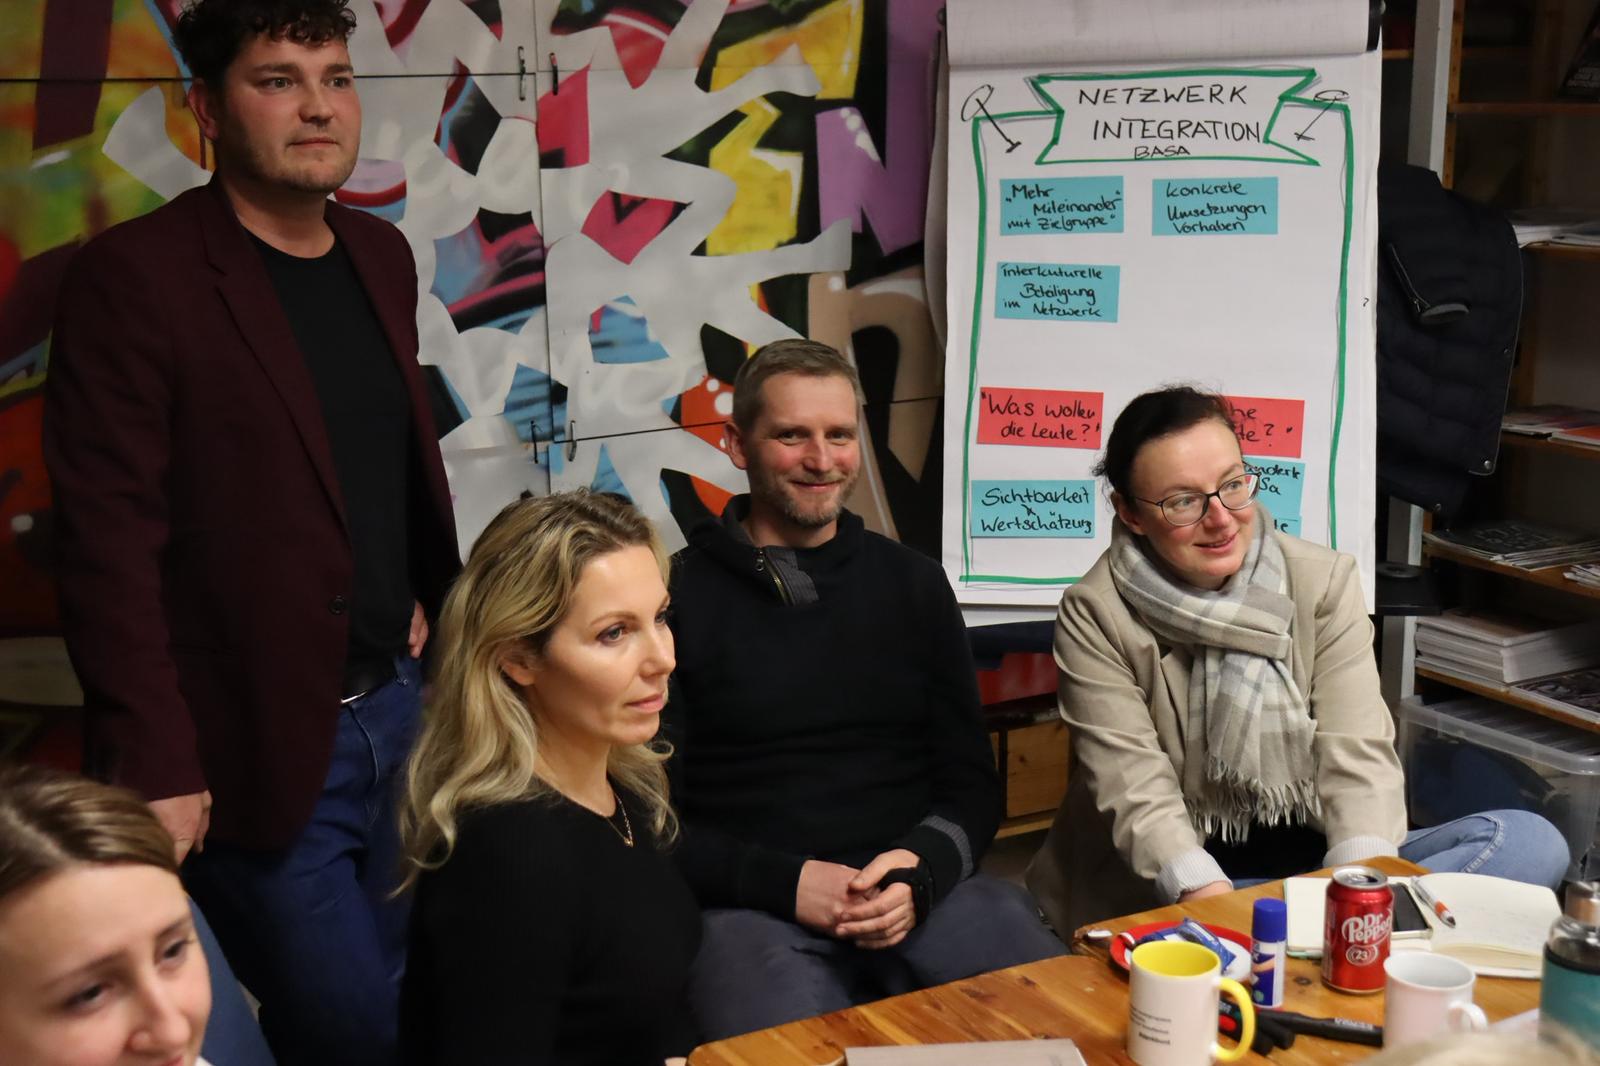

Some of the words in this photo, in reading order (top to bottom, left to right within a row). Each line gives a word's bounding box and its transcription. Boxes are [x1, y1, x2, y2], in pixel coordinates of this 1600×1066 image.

[1079, 84, 1247, 105] NETZWERK
[1093, 117, 1260, 143] INTEGRATION
[1134, 145, 1191, 160] BASA
[1002, 299, 1022, 309] im
[1033, 302, 1102, 317] Netzwerk
[1001, 421, 1025, 438] die
[981, 486, 1090, 506] Sichtbarkeit
[1346, 916, 1393, 944] Pepper
